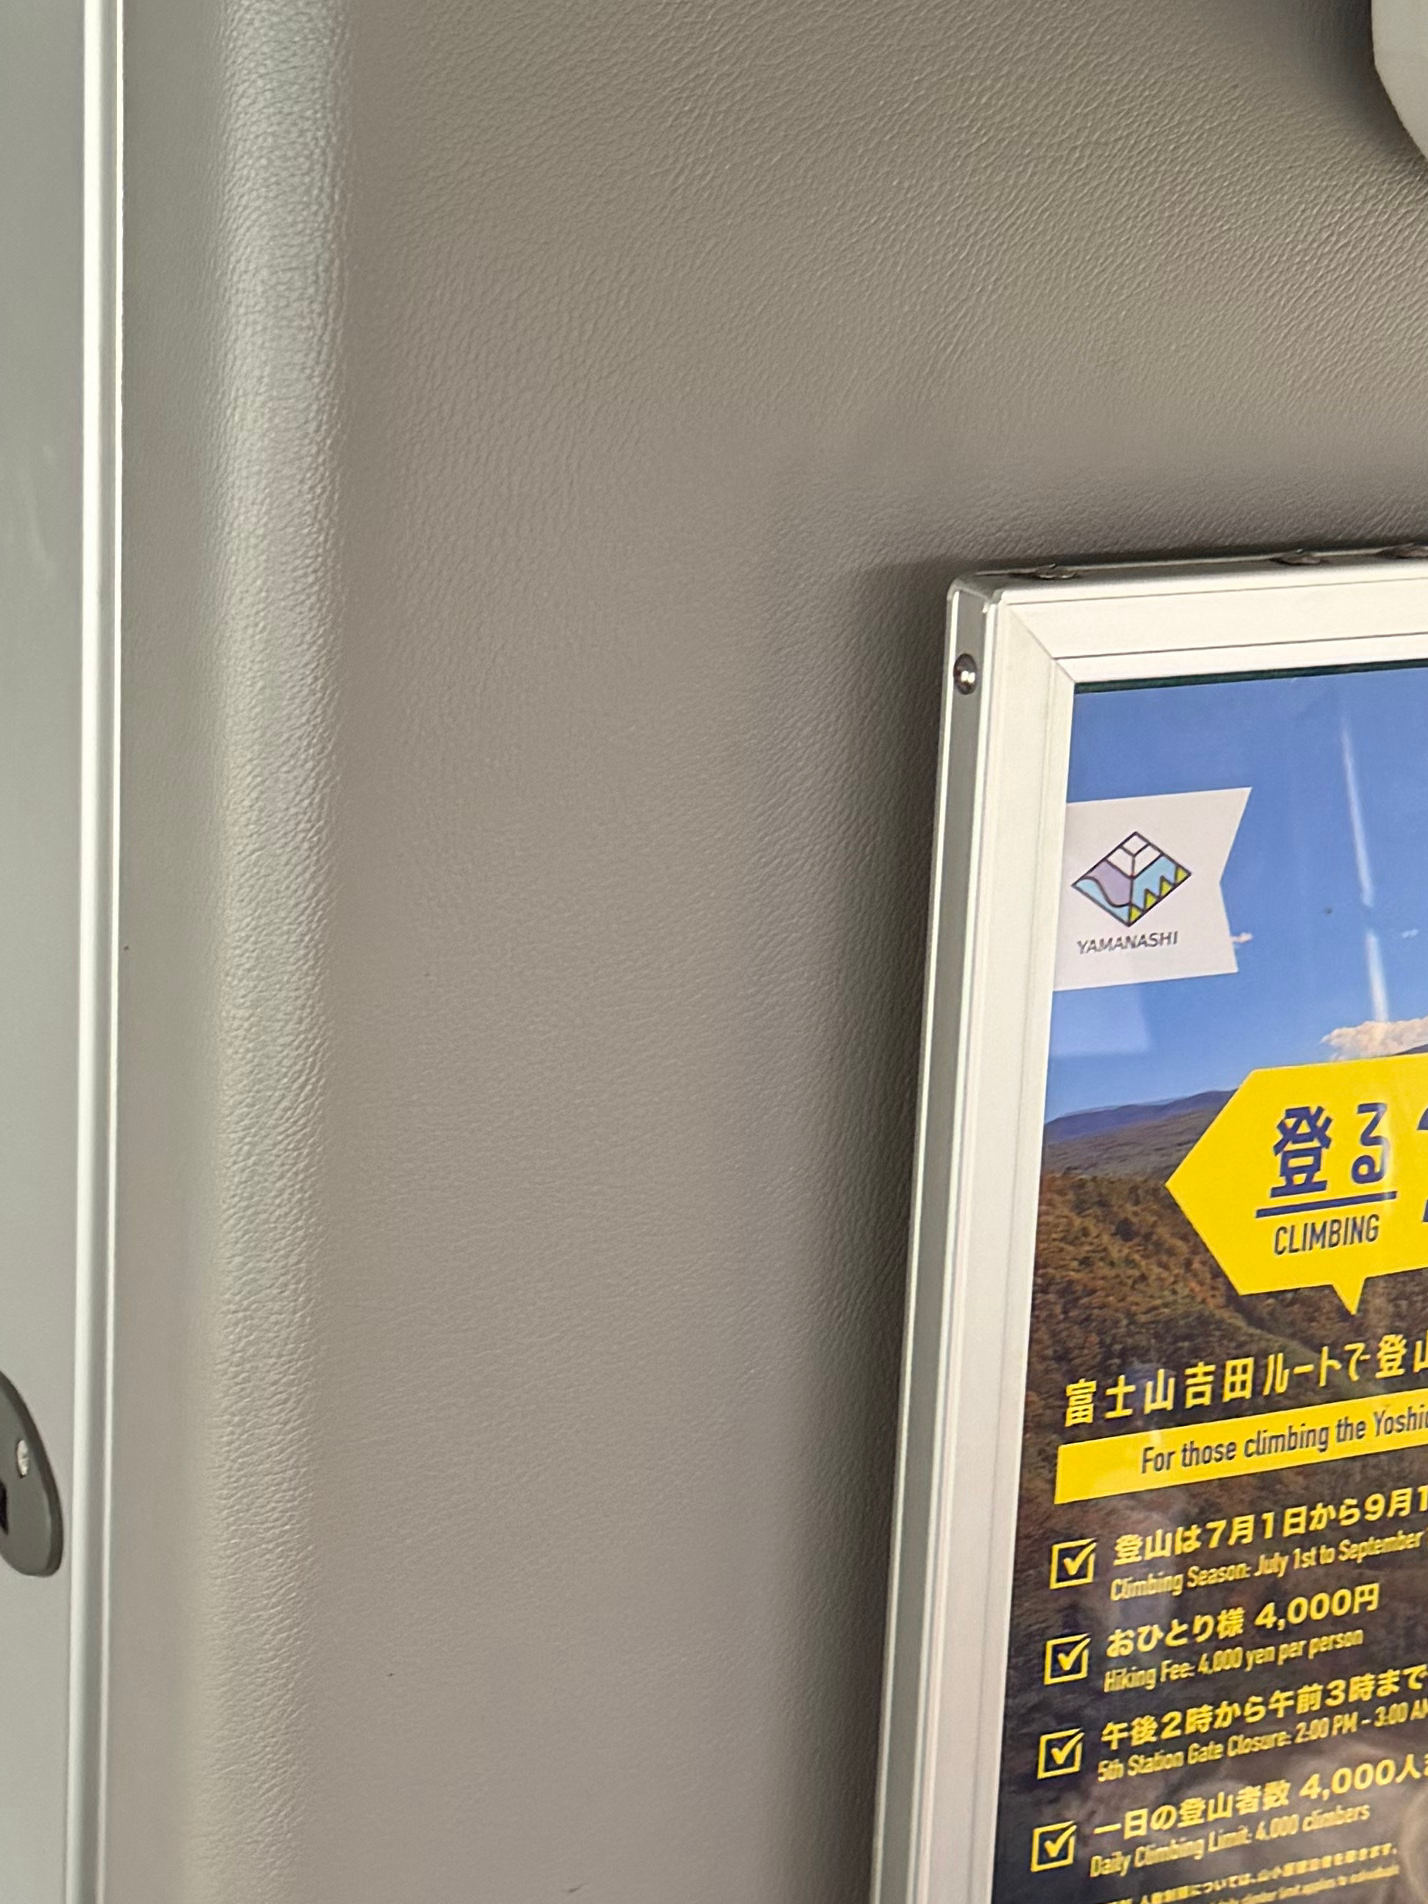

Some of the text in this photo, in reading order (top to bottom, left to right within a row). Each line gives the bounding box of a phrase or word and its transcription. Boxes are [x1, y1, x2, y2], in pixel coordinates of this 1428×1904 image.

[1077, 930, 1179, 955] YAMANASHI
[1274, 1214, 1380, 1256] CLIMBING
[1140, 1446, 1175, 1475] For
[1180, 1440, 1238, 1468] those
[1243, 1422, 1330, 1454] climbing
[1336, 1416, 1367, 1442] the
[1110, 1571, 1184, 1602] Climbing
[1254, 1551, 1290, 1578] July
[1293, 1546, 1317, 1570] 1st
[1319, 1544, 1336, 1565] to
[1338, 1529, 1426, 1563] September
[1106, 1582, 1381, 1659] おひとり様 4,000円
[1103, 1666, 1157, 1693] Hiking
[1245, 1645, 1275, 1672] yen
[1277, 1639, 1307, 1665] per
[1308, 1629, 1365, 1660] person
[1097, 1758, 1124, 1783] 5th
[1127, 1749, 1185, 1777] Station
[1187, 1742, 1224, 1765] Gate
[1331, 1711, 1360, 1737] PM
[1089, 1852, 1132, 1879] Daily
[1134, 1834, 1205, 1870] Climbing
[1302, 1802, 1371, 1833] climbers
[1093, 1779, 1291, 1841] 一日の登山者数
